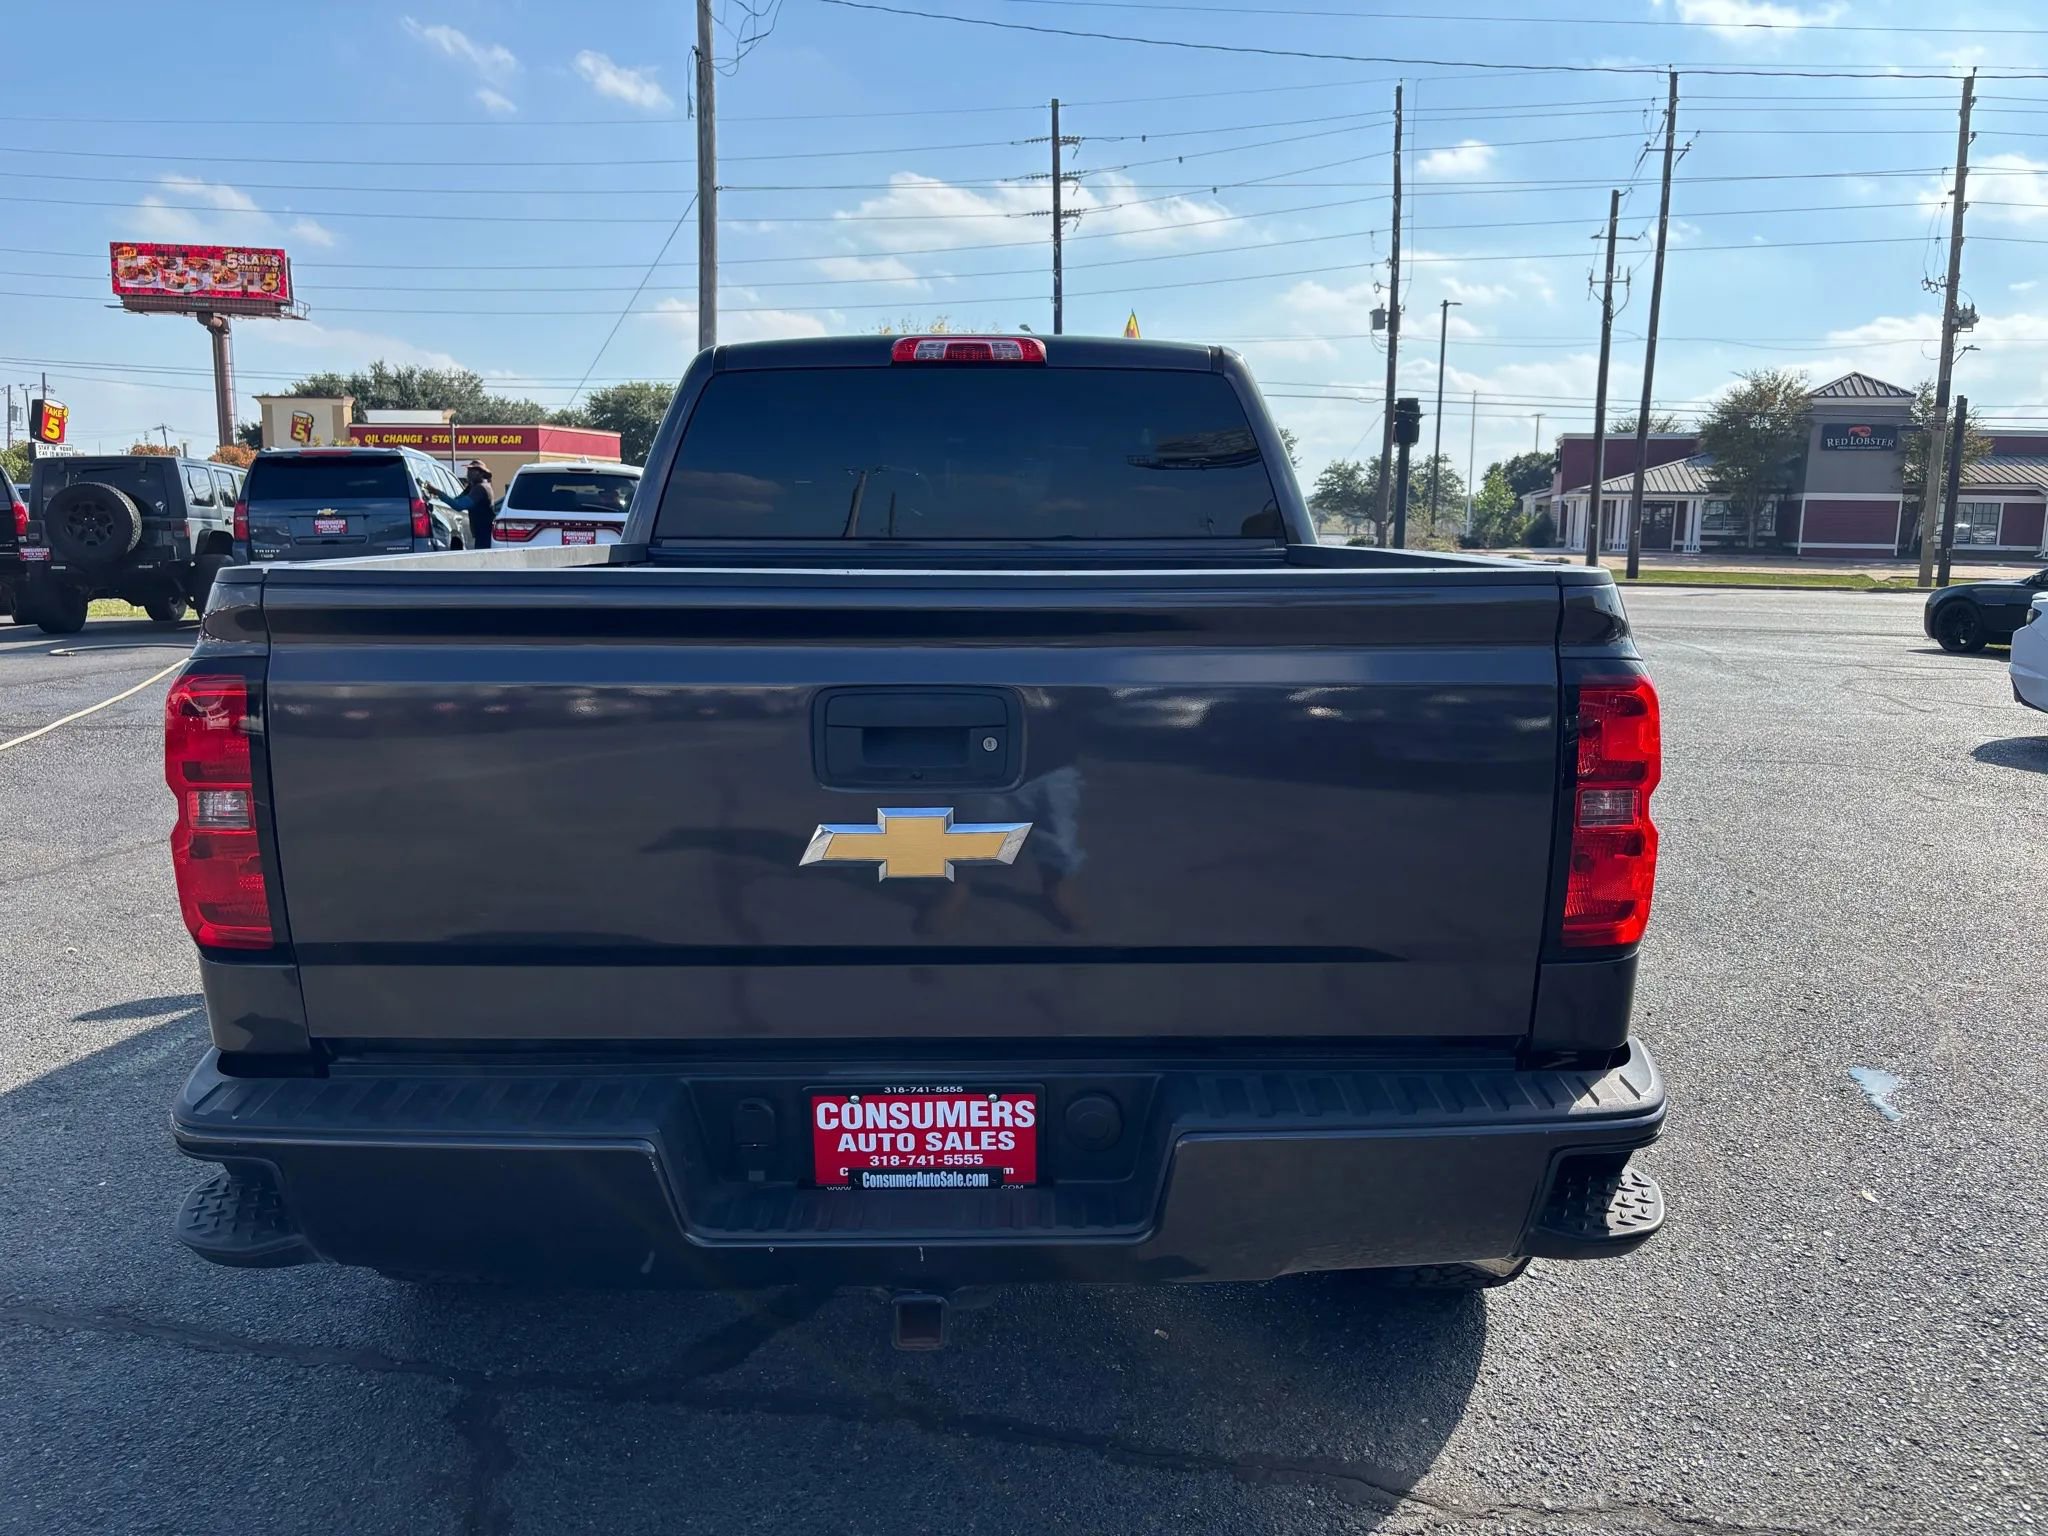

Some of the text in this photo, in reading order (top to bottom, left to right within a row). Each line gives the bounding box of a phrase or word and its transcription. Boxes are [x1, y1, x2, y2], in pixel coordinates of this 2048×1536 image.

[226, 253, 279, 270] 5 SLAMS
[44, 405, 63, 417] TAKE
[44, 417, 60, 439] 5
[294, 423, 305, 440] 5
[383, 434, 423, 444] CHANGE
[458, 435, 470, 444] IN
[472, 435, 499, 444] YOUR
[501, 435, 522, 444] CAR
[1827, 436, 1894, 447] RED LOBSTER
[816, 1100, 1035, 1130] CONSUMERS
[837, 1131, 1016, 1152] AUTO SALES
[869, 1154, 984, 1166] 318-741-5555
[862, 1171, 989, 1188] ConsumerAutoSale.com
